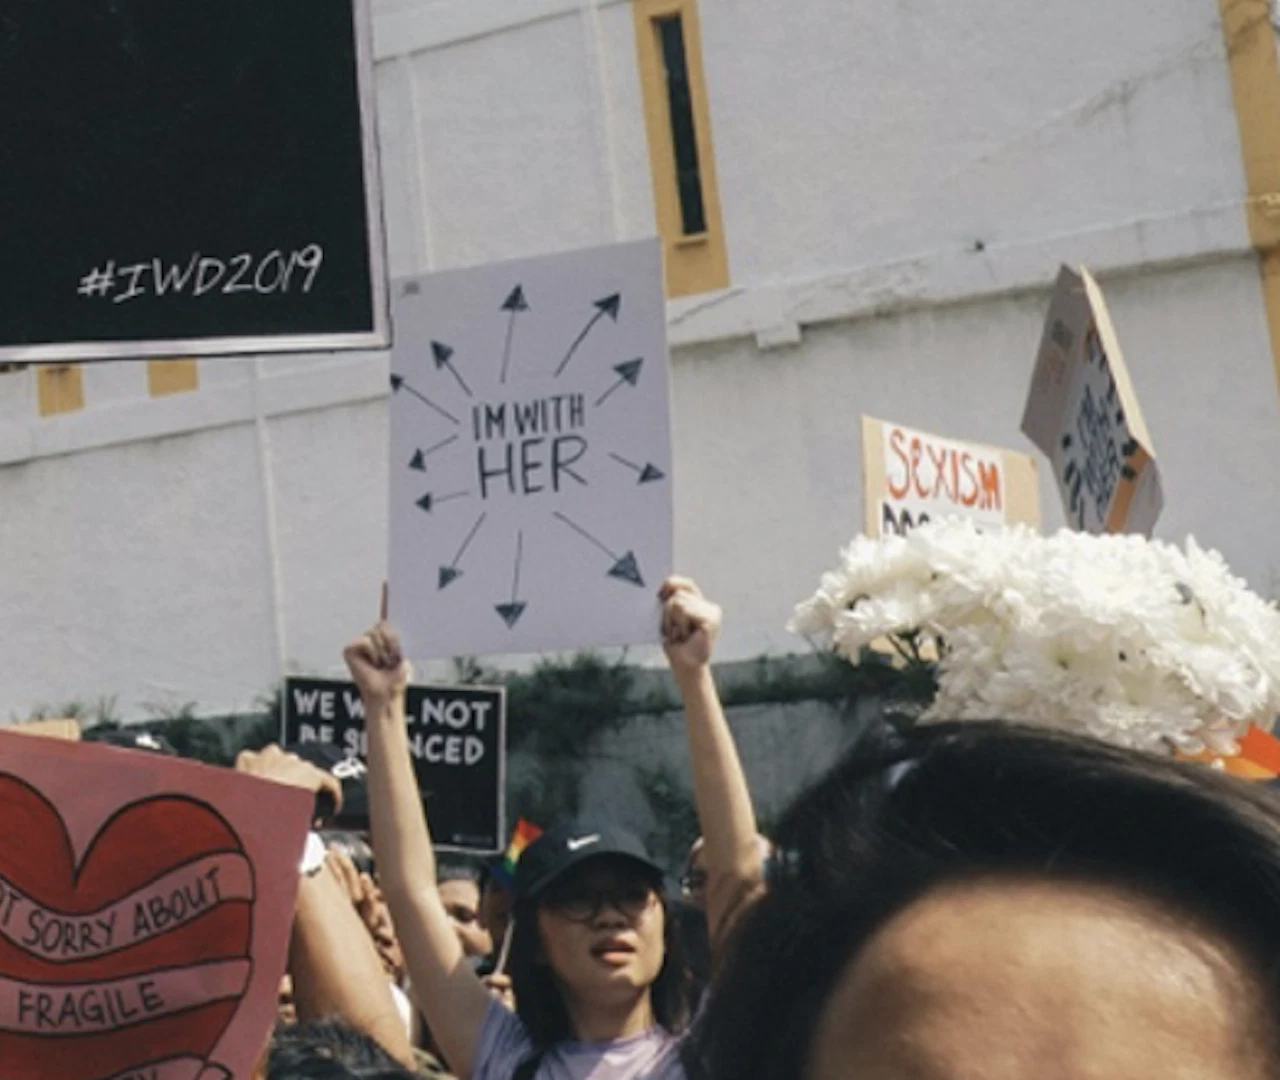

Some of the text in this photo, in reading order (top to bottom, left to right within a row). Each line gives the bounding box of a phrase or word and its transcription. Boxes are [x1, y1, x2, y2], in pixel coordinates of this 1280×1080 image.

[77, 243, 323, 304] #IWD2019
[513, 392, 585, 436] WITH
[477, 434, 589, 500] HER
[293, 687, 336, 720] WE
[421, 697, 492, 732] NOT
[22, 908, 118, 955] SORRY
[134, 866, 222, 937] ABOUT
[18, 980, 166, 1027] FRAGILE
